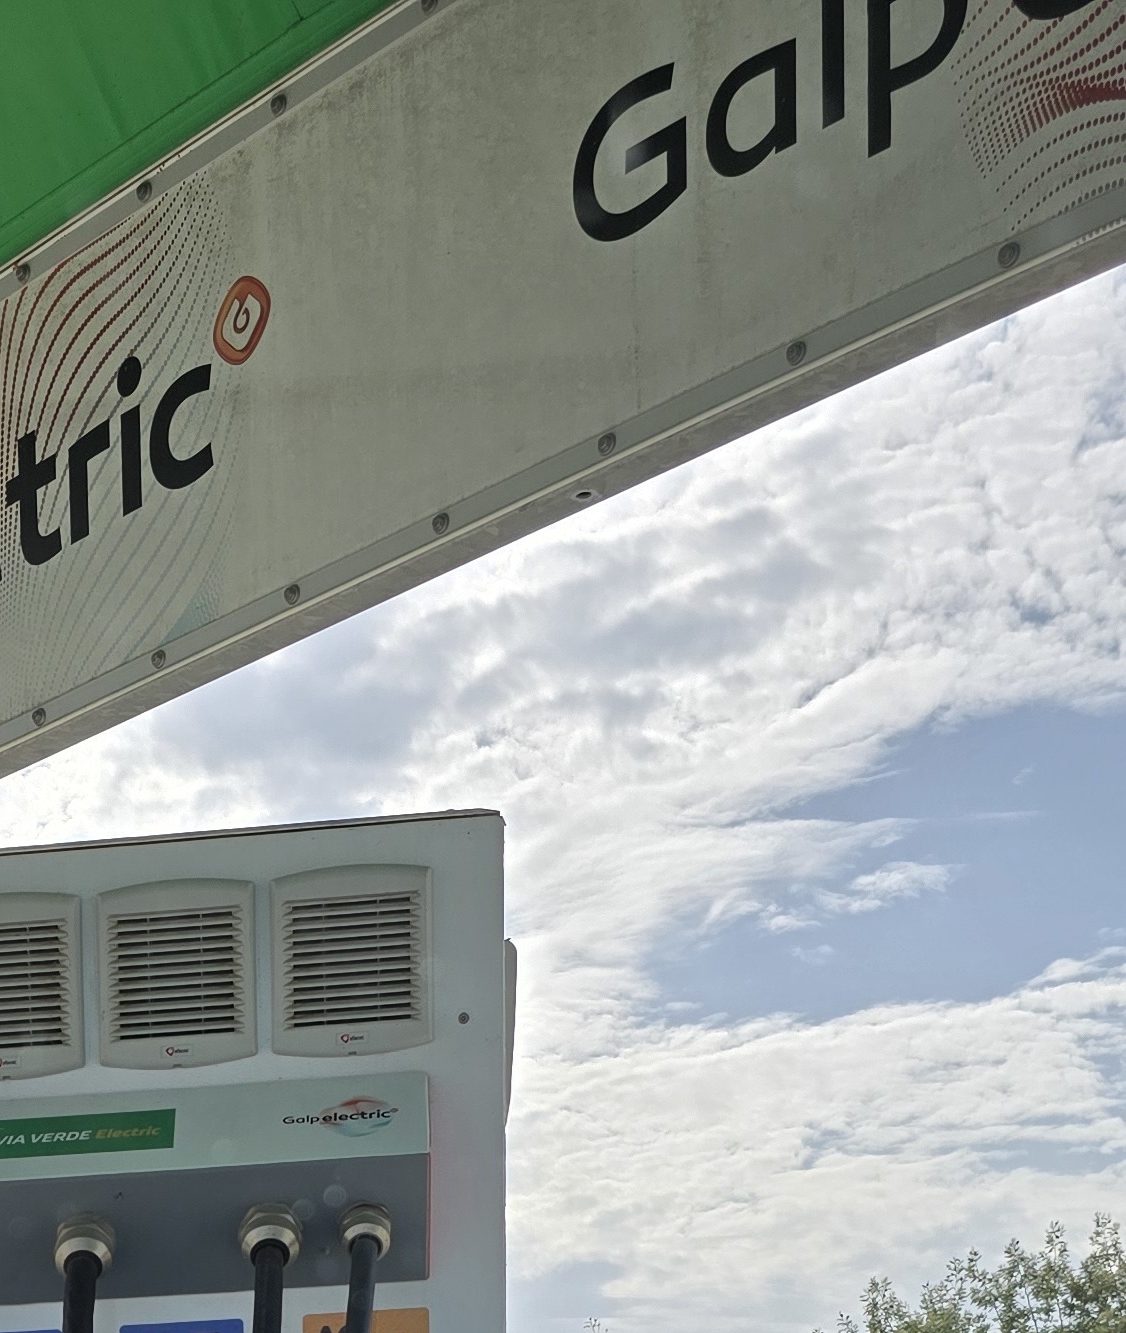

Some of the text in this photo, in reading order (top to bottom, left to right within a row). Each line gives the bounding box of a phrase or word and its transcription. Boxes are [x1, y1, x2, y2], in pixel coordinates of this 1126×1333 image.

[573, 0, 1095, 242] Galp
[31, 1129, 92, 1143] VERDE
[95, 1125, 161, 1139] Electric
